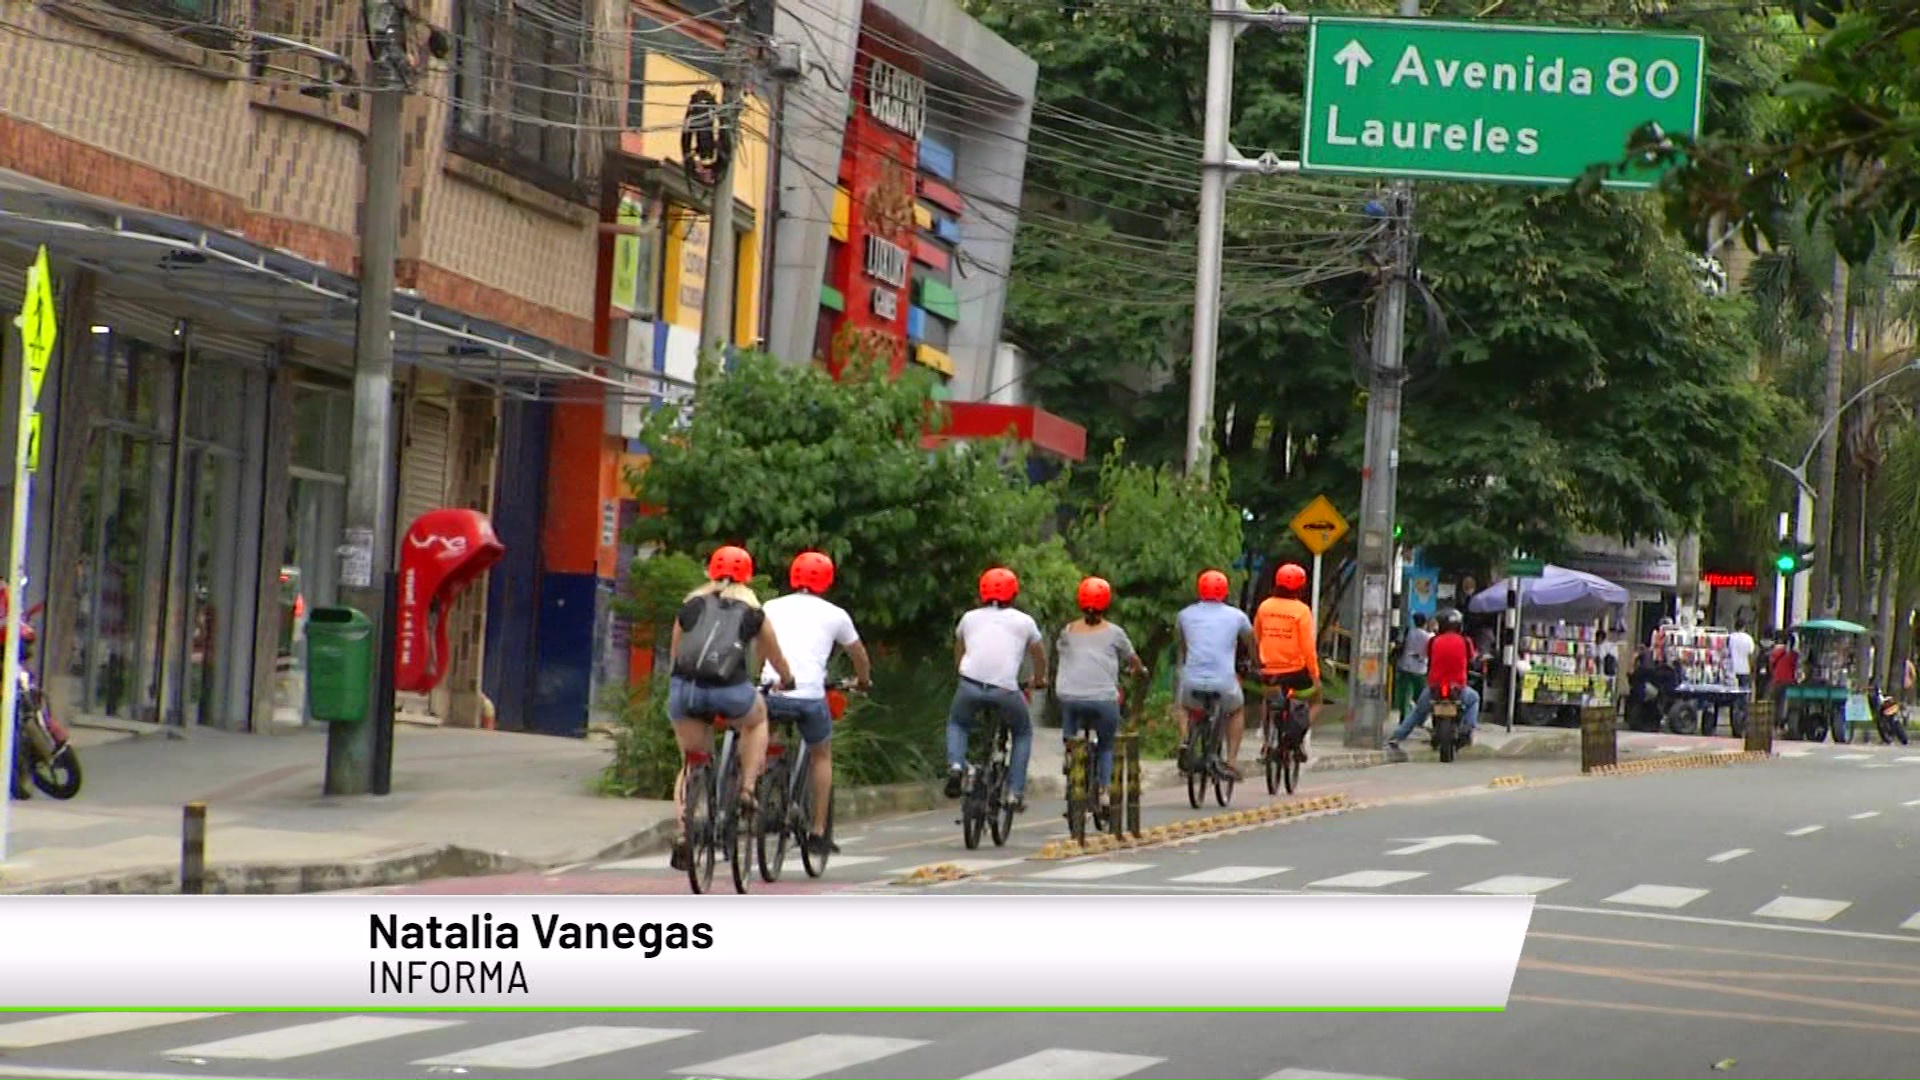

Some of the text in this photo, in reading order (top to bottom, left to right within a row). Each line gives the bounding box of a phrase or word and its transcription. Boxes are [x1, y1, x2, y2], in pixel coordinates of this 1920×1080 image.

[1391, 44, 1680, 99] Avenida 80
[868, 61, 927, 140] CASINO
[1326, 104, 1539, 155] Laureles
